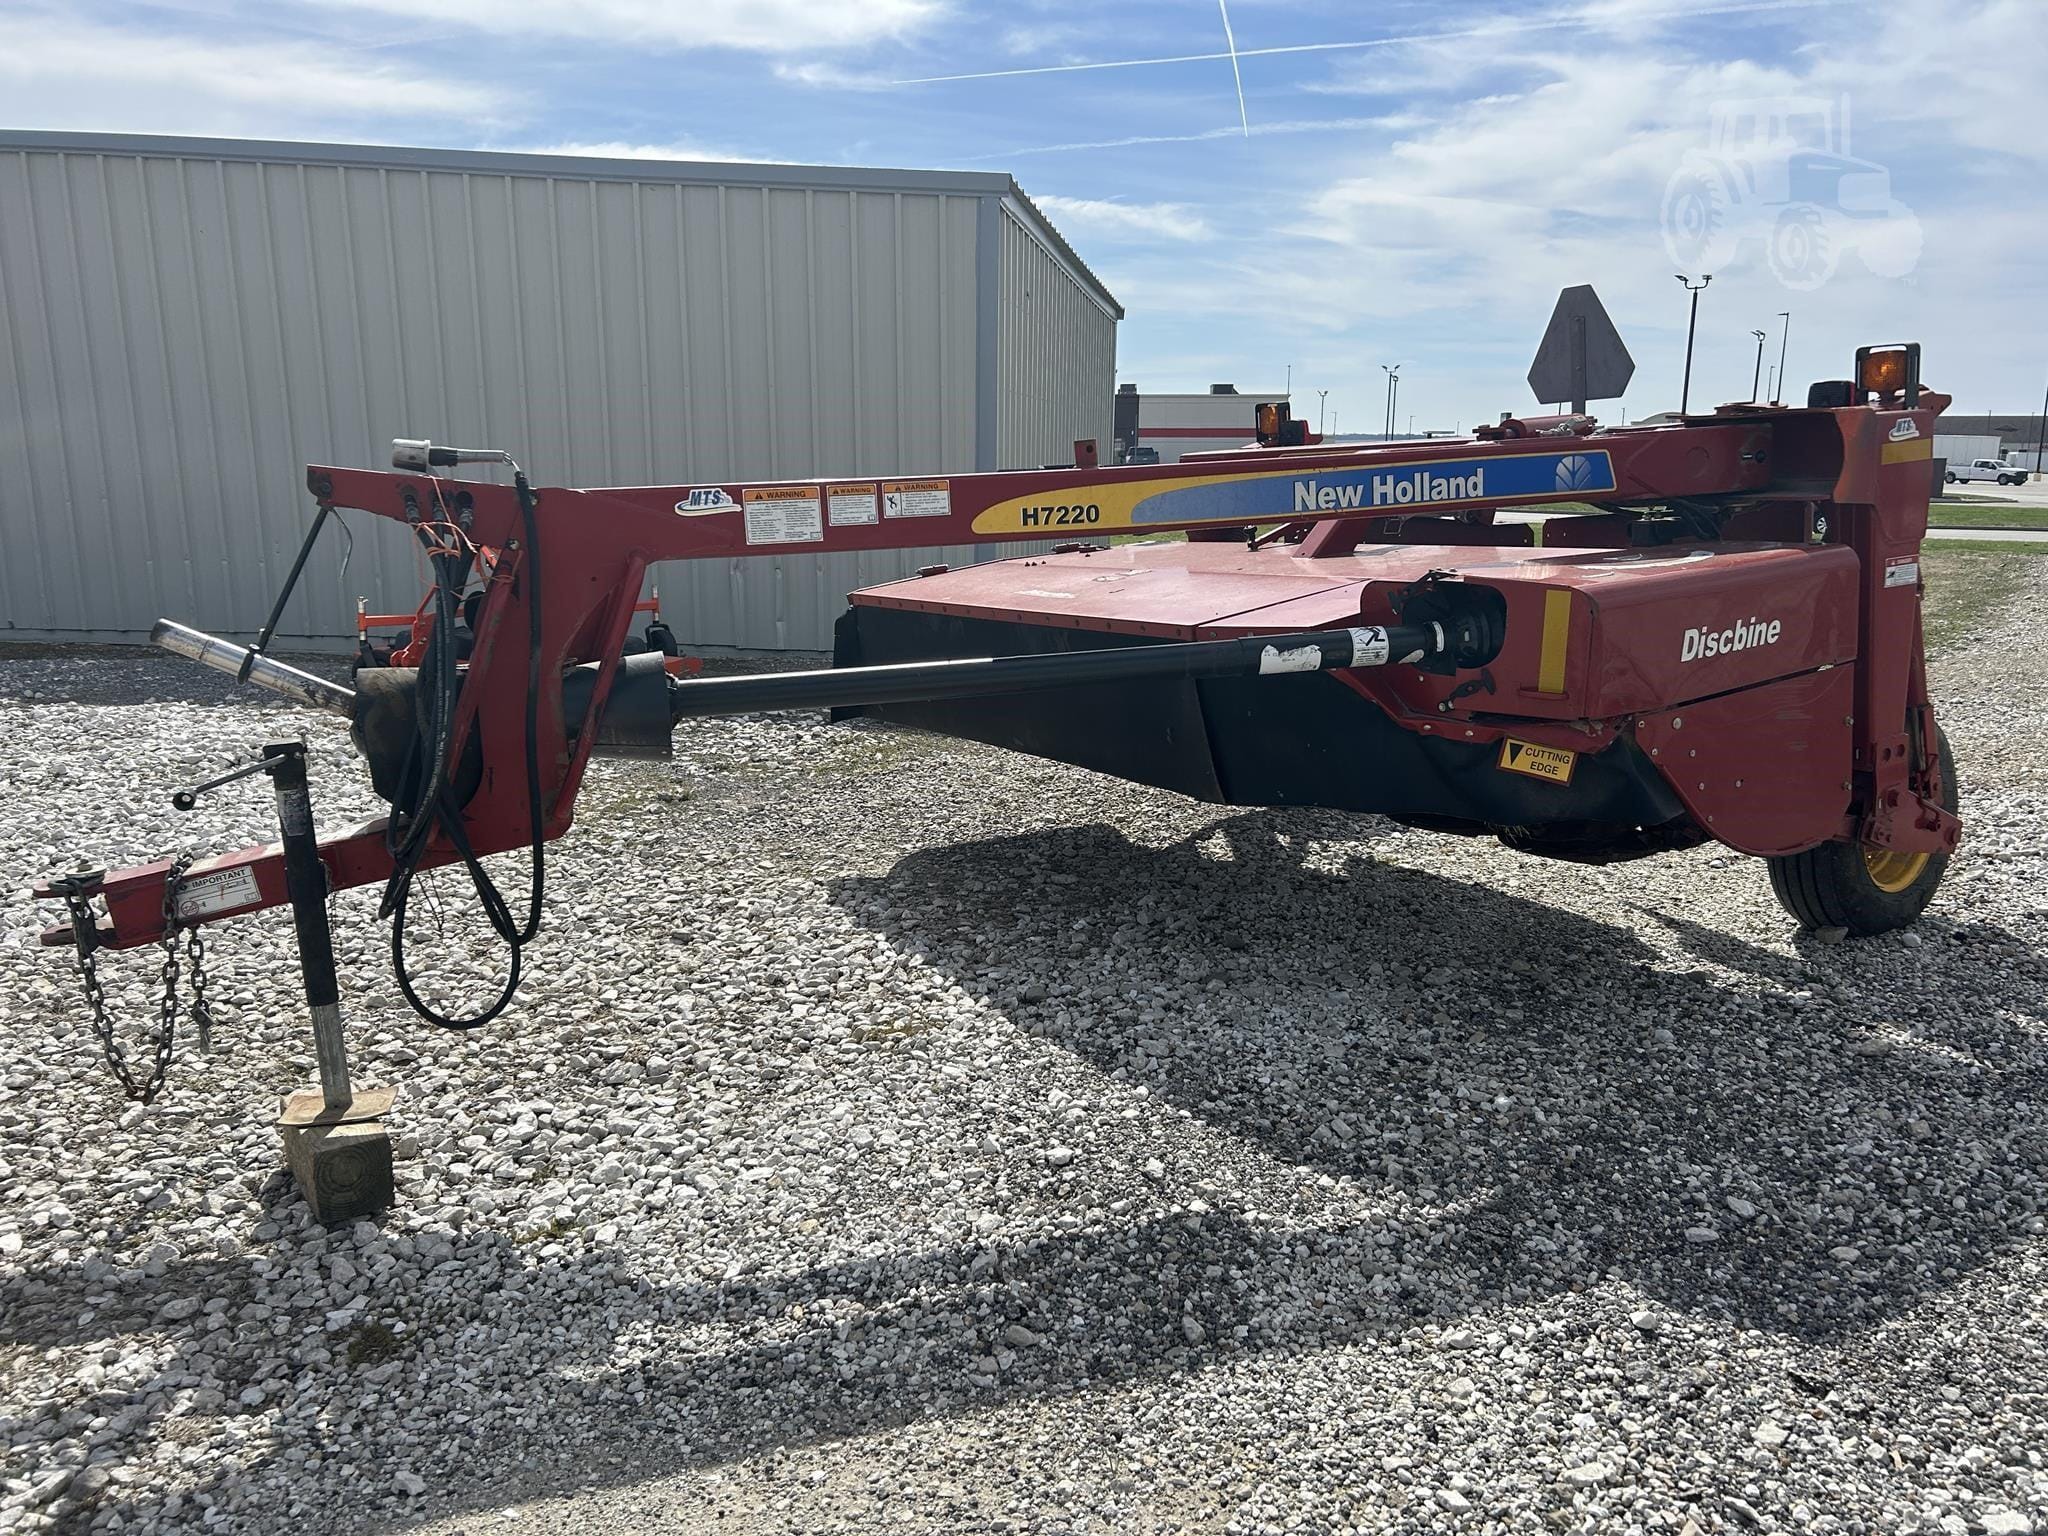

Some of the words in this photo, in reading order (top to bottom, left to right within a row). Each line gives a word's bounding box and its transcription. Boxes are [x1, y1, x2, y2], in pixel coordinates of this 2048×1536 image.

[766, 490, 806, 499] WARNING
[903, 483, 939, 491] WARNING
[1293, 480, 1364, 512] New
[1372, 468, 1484, 505] Holland
[690, 489, 721, 506] MTS
[1021, 504, 1100, 527] H7220
[1680, 616, 1781, 663] Discbine
[1525, 747, 1570, 765] CUTTING
[1530, 761, 1559, 776] EDGE
[191, 869, 246, 889] IMPORTANT
